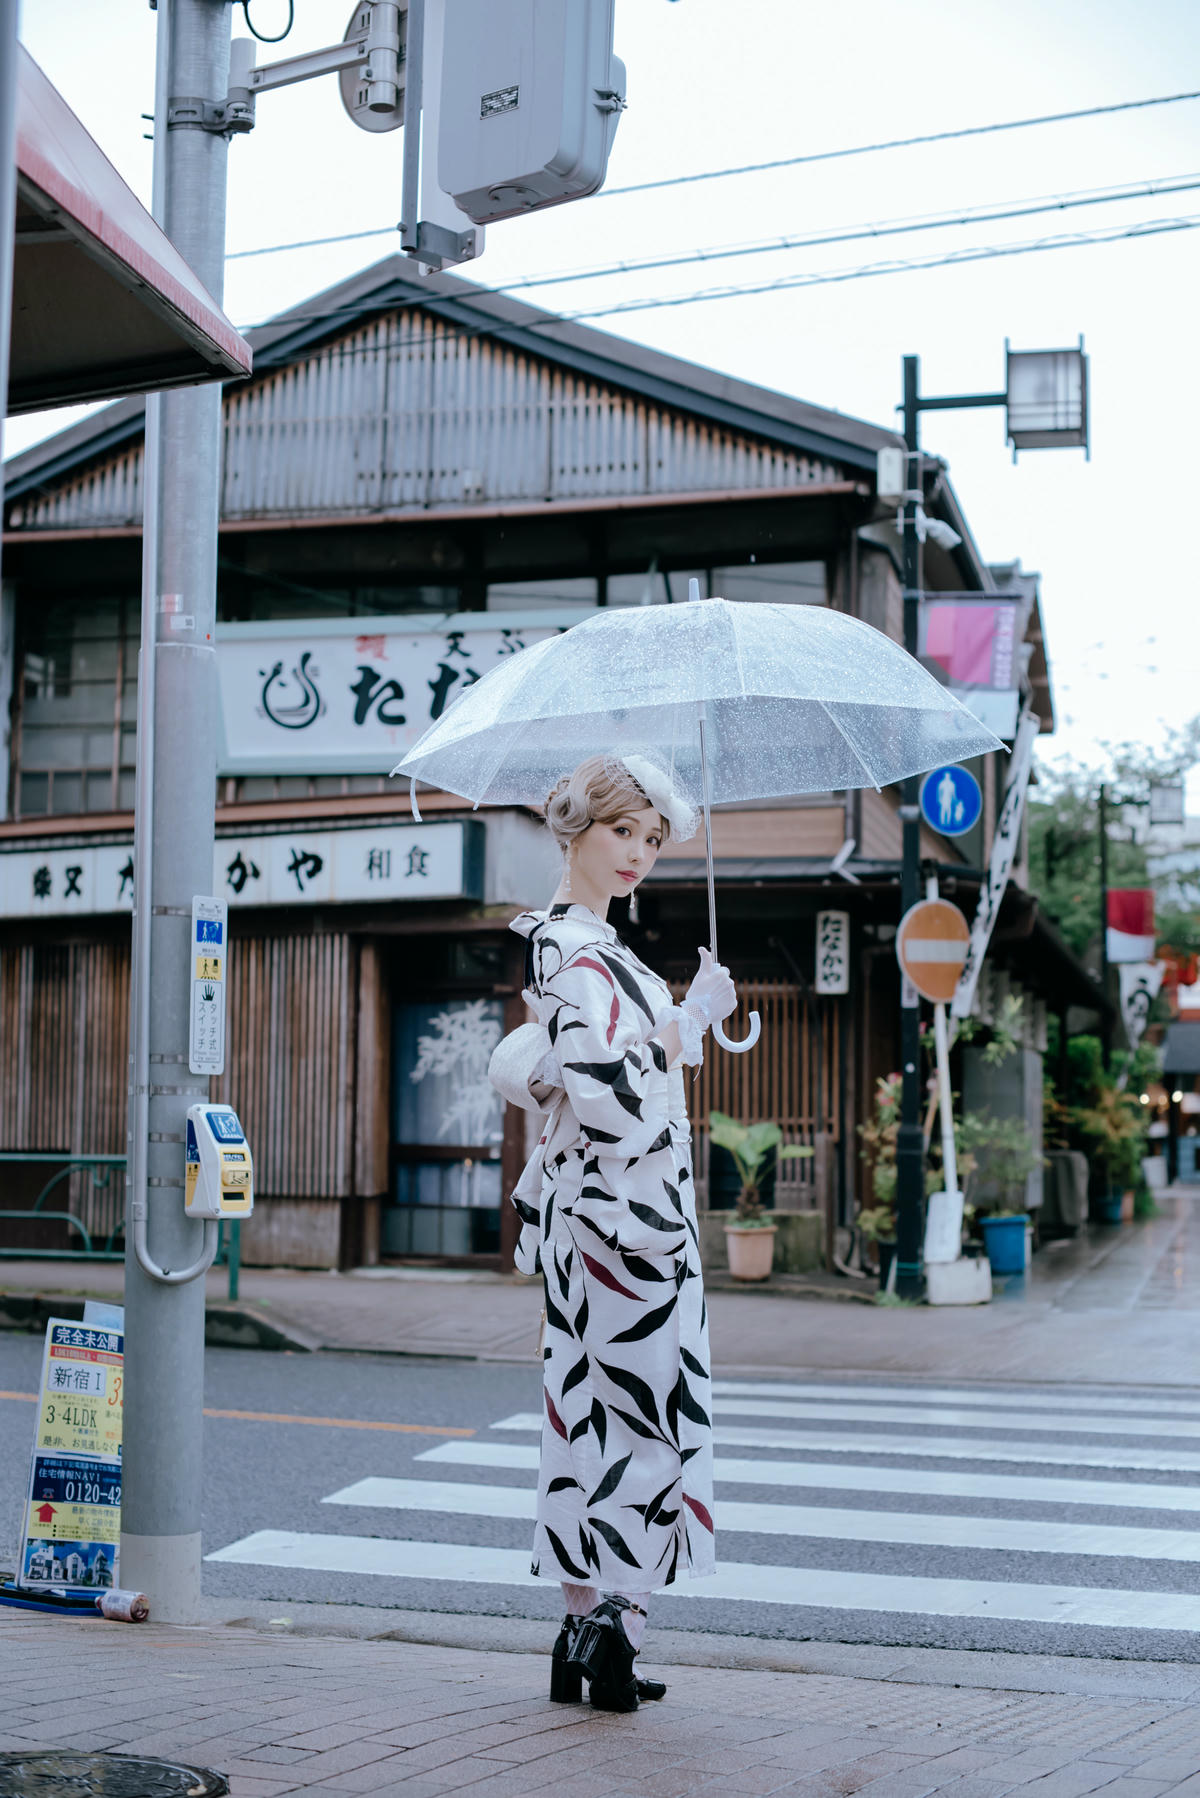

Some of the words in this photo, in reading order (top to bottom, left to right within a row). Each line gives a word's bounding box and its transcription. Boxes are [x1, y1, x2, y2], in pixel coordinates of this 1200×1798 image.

[367, 845, 429, 880] 和食
[55, 1327, 119, 1352] 完全未公開
